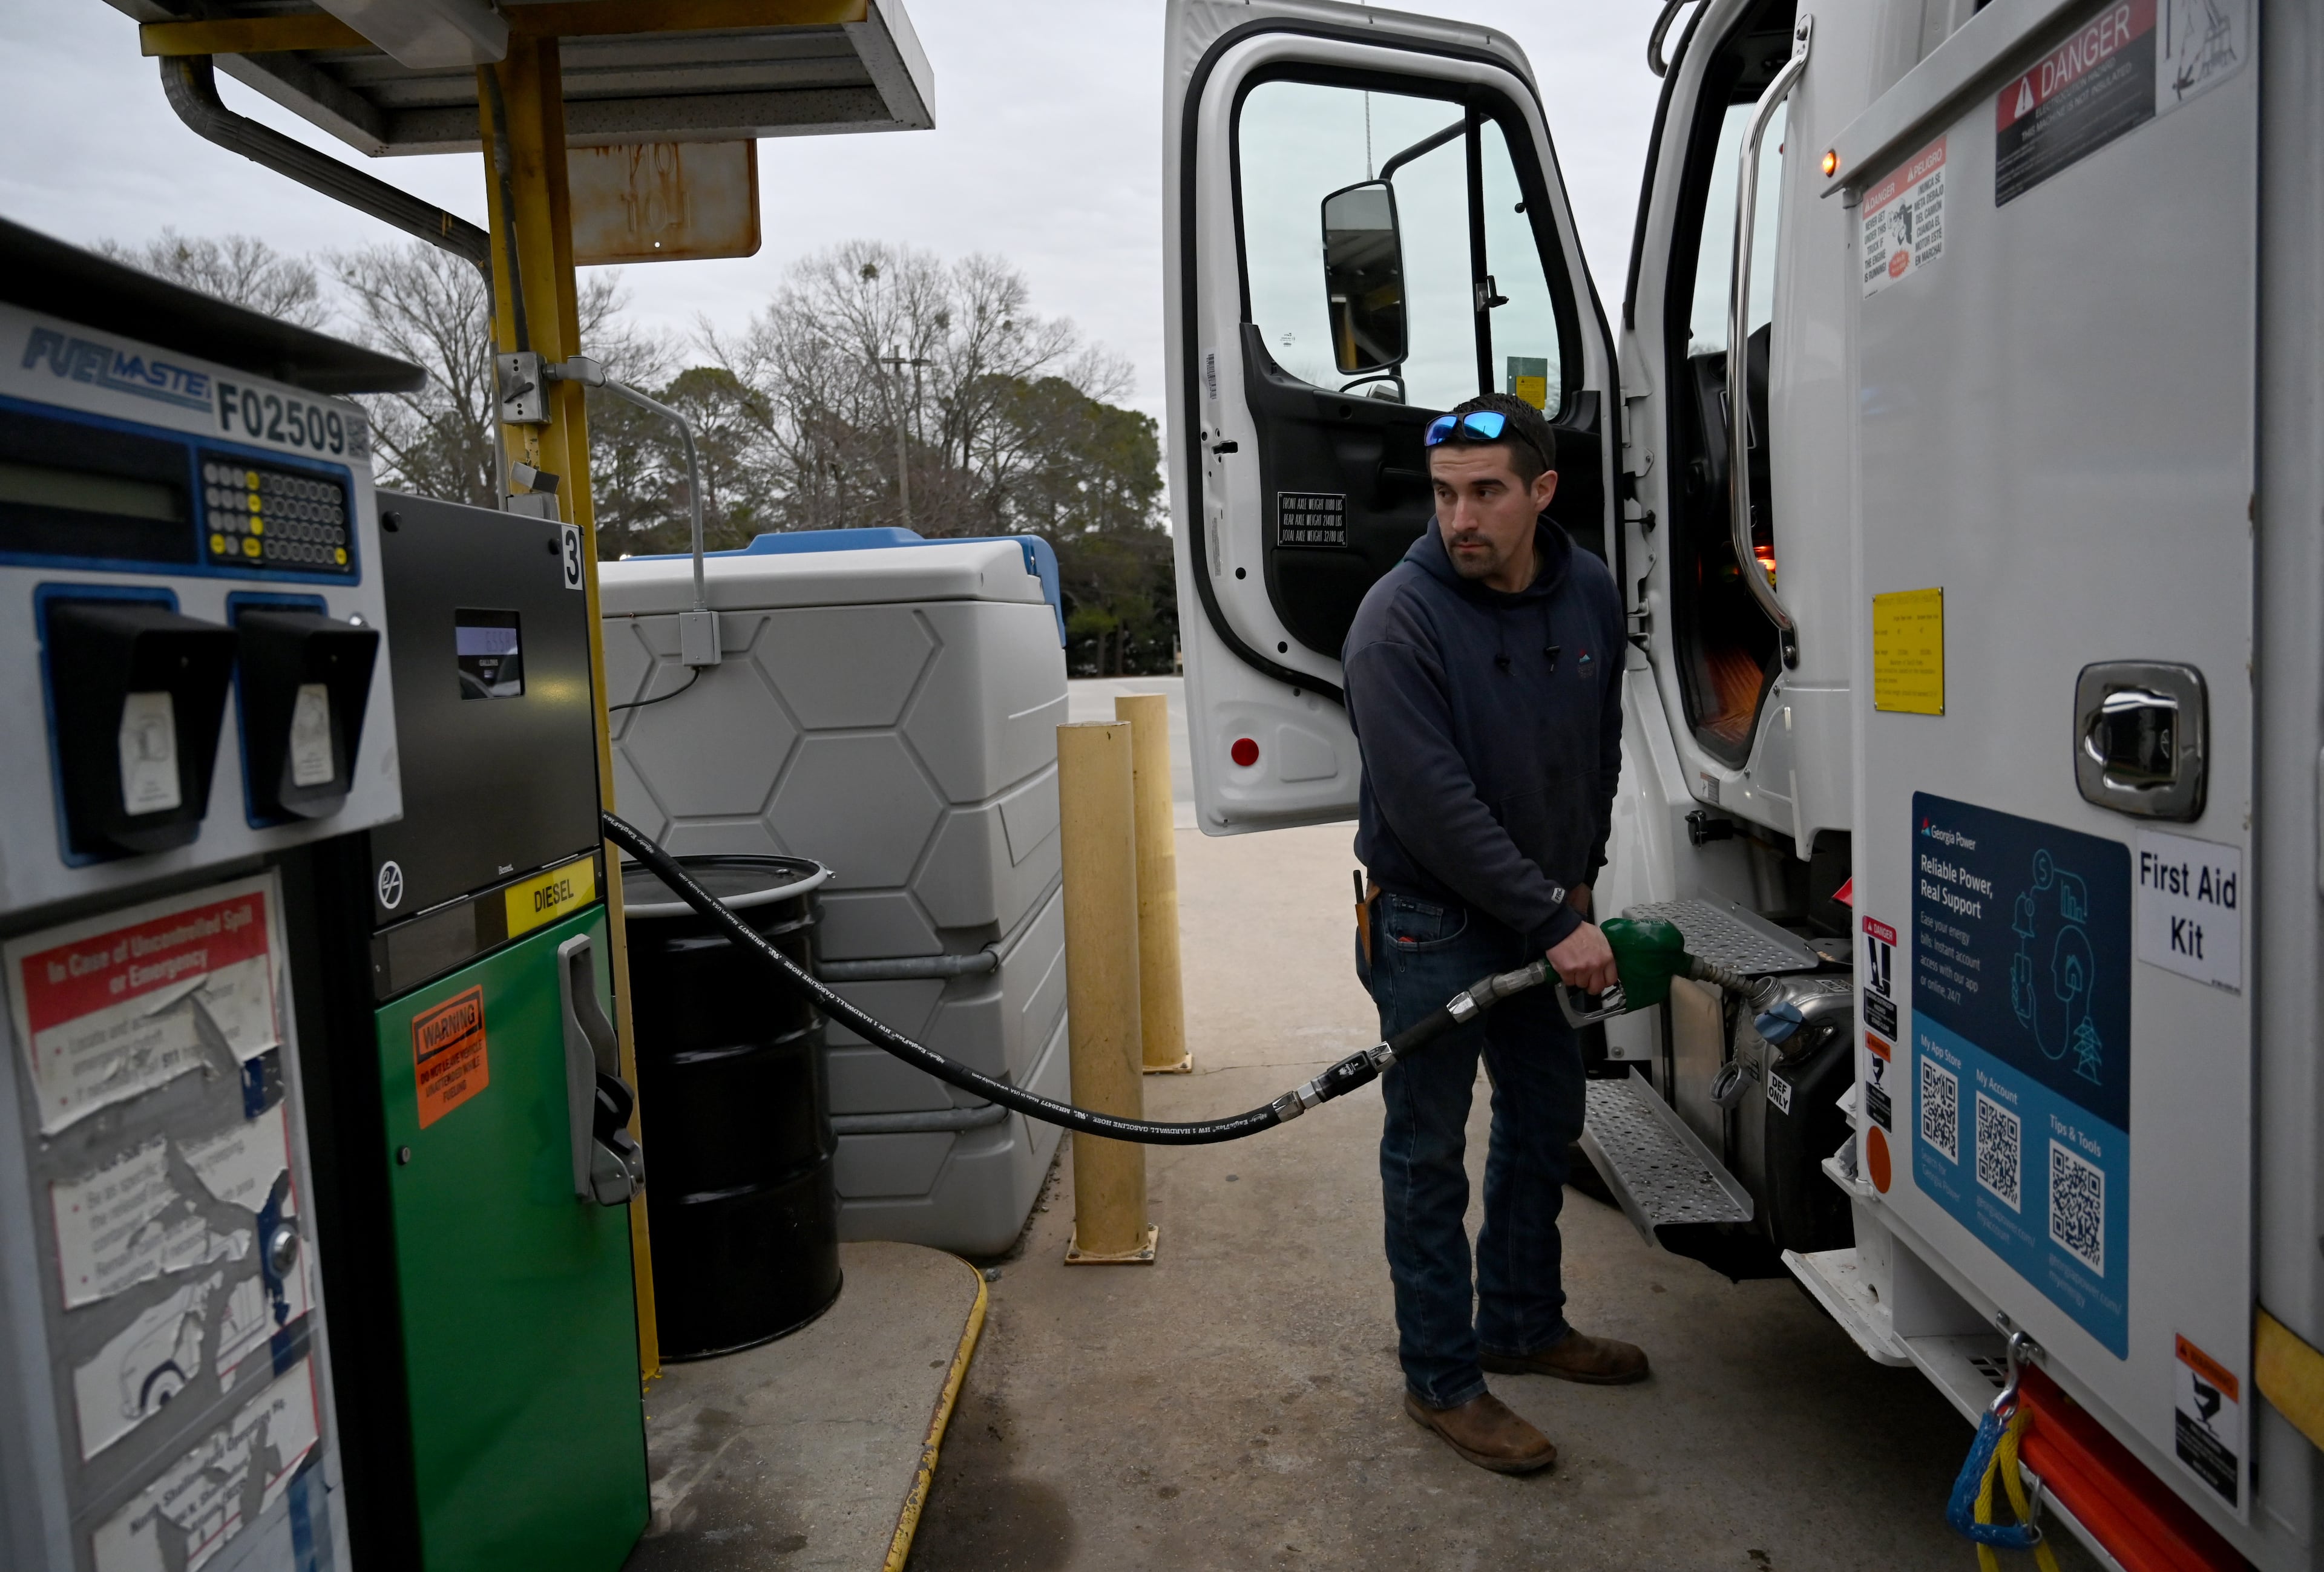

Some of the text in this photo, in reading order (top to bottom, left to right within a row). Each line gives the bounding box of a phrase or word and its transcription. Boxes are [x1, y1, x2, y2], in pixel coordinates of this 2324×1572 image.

[2041, 4, 2130, 99] DANGER
[1913, 147, 1943, 179] PELIGRO
[1869, 182, 1895, 209] DANGER
[1926, 183, 1944, 204] DEBAJO
[1864, 222, 1886, 245] UNDER THIS
[1865, 214, 1877, 232] NEVER
[1867, 240, 1879, 256] TRUCK
[1915, 234, 1930, 252] MOTOR
[1873, 249, 1886, 266] ENGINE
[216, 382, 344, 456] F02509
[1283, 497, 1296, 509] FRONT
[1297, 498, 1307, 510] AXLE
[1308, 498, 1324, 511] WEIGHT
[1284, 513, 1295, 526] REAR
[1295, 514, 1305, 526] AXLE
[1307, 514, 1322, 526] WEIGHT
[1282, 529, 1295, 542] TOTAL
[1296, 529, 1306, 542] AXLE
[1307, 530, 1323, 542] WEIGHT
[565, 529, 580, 586] 3
[1931, 824, 1976, 851] Georgia Power
[678, 871, 712, 903] www.husky.com
[1920, 854, 1994, 899] Reliable Power,
[2141, 851, 2237, 911] First Aid
[534, 878, 574, 913] DIESEL
[712, 901, 722, 912] USA
[1920, 879, 1981, 919] Real Support
[726, 912, 739, 926] Made
[1920, 910, 1971, 946] Ease your energy
[47, 905, 254, 984] In Case of Uncontrolled Spill
[738, 925, 766, 948] MH20477
[1874, 923, 1893, 942] DANGER
[2171, 914, 2204, 961] Kit
[130, 947, 209, 986] Emergency
[784, 960, 803, 977] HOSE
[1955, 951, 1981, 972] account
[1920, 954, 1979, 994] access with our app
[1920, 975, 1927, 986] or
[801, 973, 835, 1000] GASOLINE
[836, 998, 873, 1023] HARDWALL
[424, 1003, 476, 1050] WARNING
[879, 1024, 891, 1035] HW
[420, 1038, 482, 1085] DO NOT LEAVE VEHICLE
[1920, 1033, 1961, 1070] My App Store
[426, 1055, 481, 1098] UNATTENDED WHILE
[971, 1072, 1009, 1092] www.husky.com
[1772, 1075, 1787, 1095] DEF
[1976, 1068, 2019, 1105] My Account
[443, 1079, 467, 1103] FUELING
[1010, 1087, 1020, 1096] USA
[1026, 1095, 1039, 1104] Made
[1768, 1086, 1788, 1110] ONLY
[1040, 1099, 1071, 1114] MH20477
[1092, 1116, 1112, 1127] HOSE
[1113, 1121, 1149, 1133] GASOLINE
[2049, 1113, 2102, 1158] Tips & Tools
